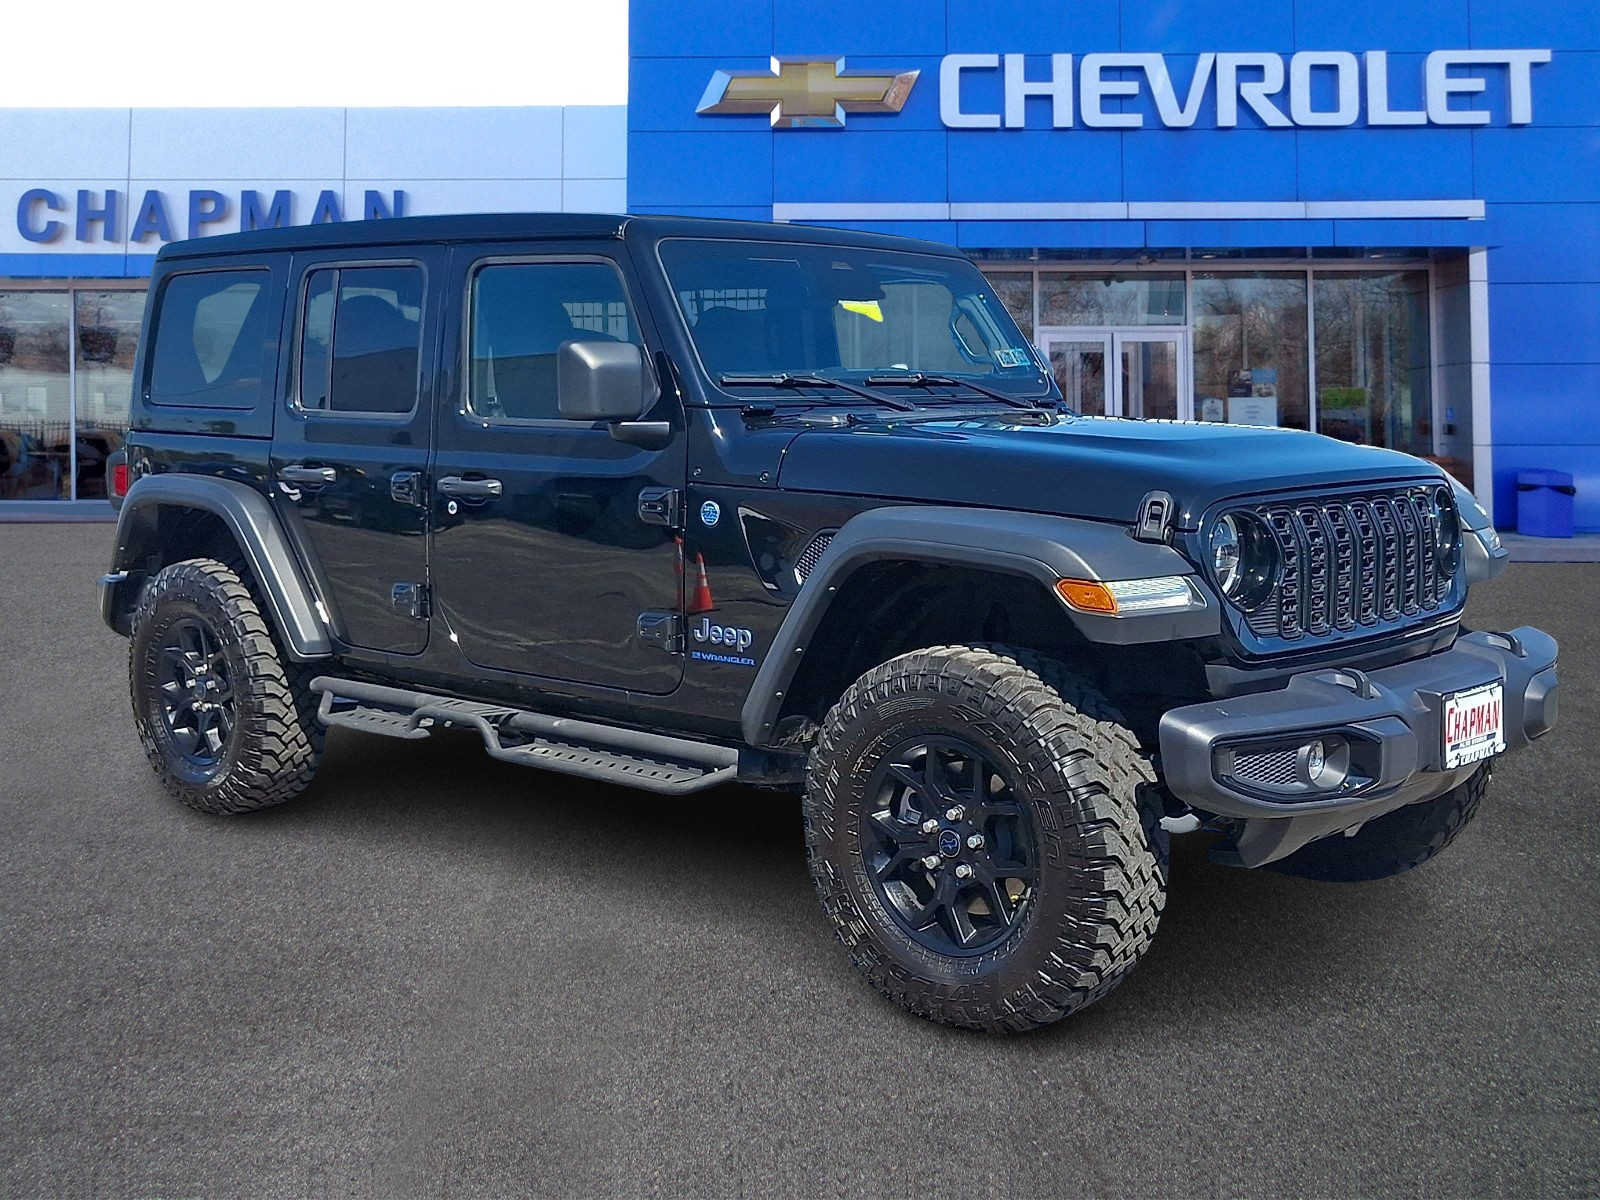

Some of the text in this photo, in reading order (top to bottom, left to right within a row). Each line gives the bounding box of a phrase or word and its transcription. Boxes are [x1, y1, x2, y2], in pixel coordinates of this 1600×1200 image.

[939, 49, 1552, 128] CHEVROLET
[16, 188, 408, 243] CHAPMAN
[693, 617, 752, 653] Jeep
[701, 651, 756, 666] WRANGLER
[1446, 699, 1500, 744] CHAPMAN
